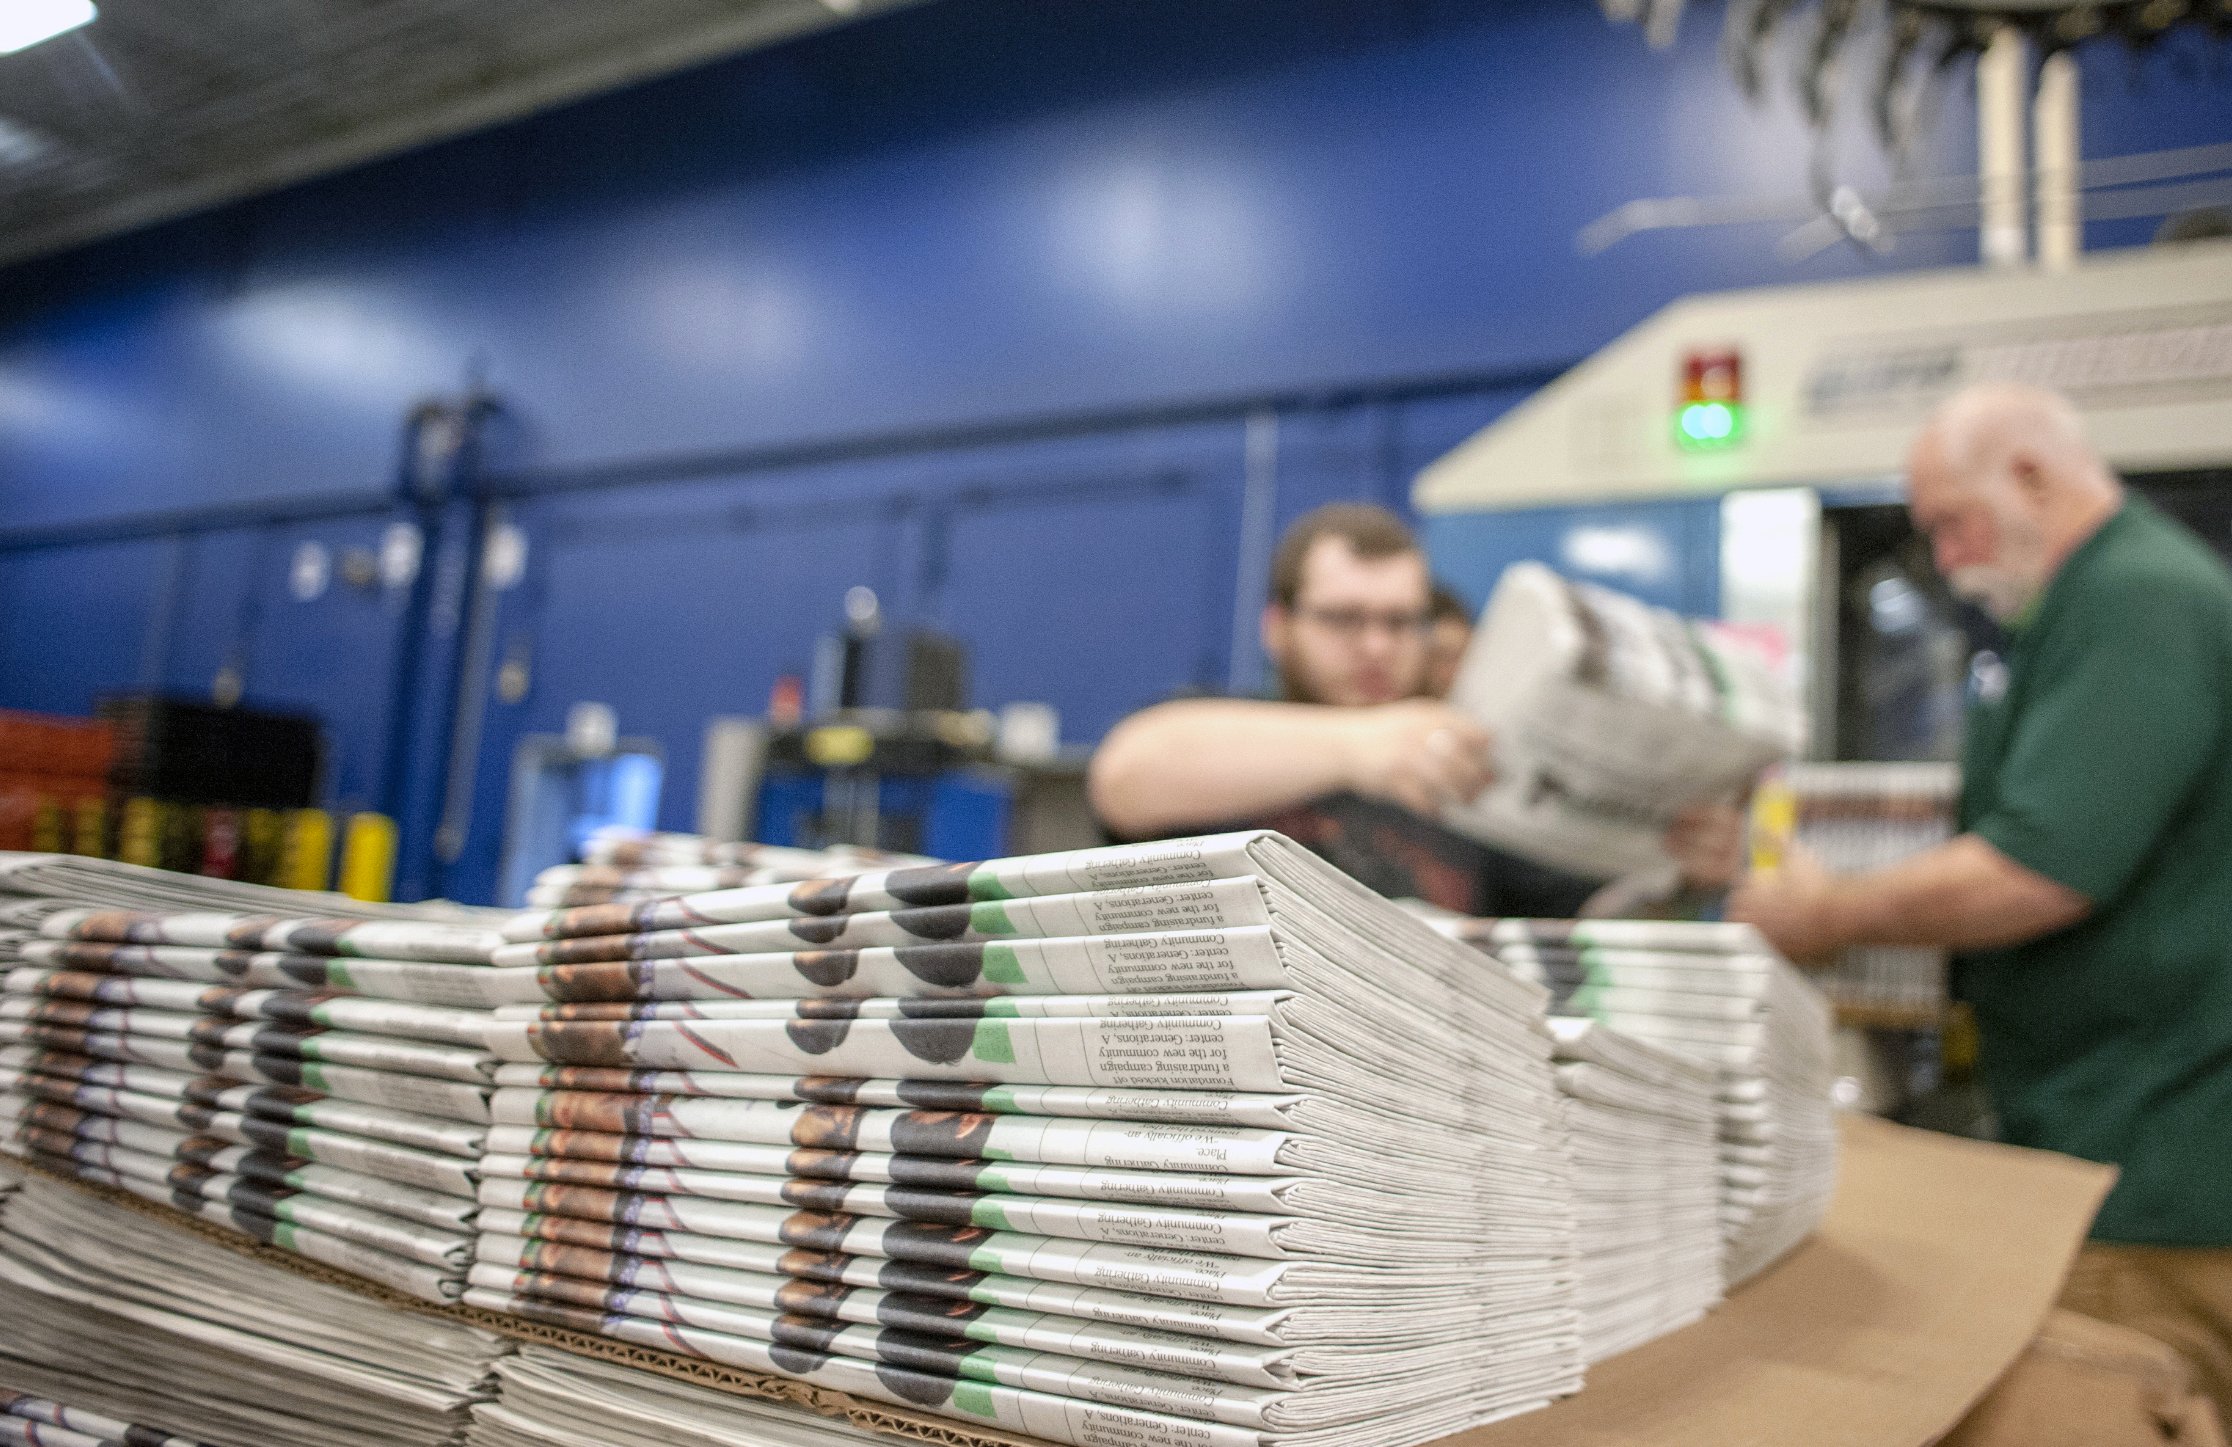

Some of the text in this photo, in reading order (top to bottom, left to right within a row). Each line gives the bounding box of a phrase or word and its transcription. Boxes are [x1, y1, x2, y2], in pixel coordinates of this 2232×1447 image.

[1094, 891, 1214, 911] center: Generations, A
[1182, 905, 1200, 914] the
[1202, 903, 1220, 913] for
[1095, 909, 1154, 922] community
[1098, 914, 1224, 932] a fundraising campaign
[1104, 934, 1225, 950] Community Gathering
[1108, 946, 1229, 963] center: Generations, A
[1107, 964, 1167, 974] community
[1196, 962, 1214, 971] the
[1217, 959, 1234, 970] for
[1111, 976, 1164, 986] campaign
[1167, 972, 1230, 982] fundraising
[1100, 1019, 1222, 1031] Community Gathering
[1102, 1034, 1224, 1045] center: Generations, A
[1099, 1047, 1227, 1060] for the new community
[1100, 1060, 1230, 1074] a fundraising campaign
[1113, 1076, 1235, 1086] Foundation kicked off
[1105, 1095, 1229, 1111] Community Gathering
[1123, 1130, 1142, 1139] an-
[1144, 1130, 1193, 1143] officially
[1100, 1180, 1225, 1198] Community Gathering
[1098, 1213, 1222, 1234] Community Gathering
[1143, 1253, 1194, 1266] officially
[1094, 1267, 1220, 1291] Community Gathering
[1093, 1307, 1219, 1333] Community Gathering
[1090, 1342, 1216, 1369] Community Gathering
[1084, 1409, 1094, 1420] A
[1096, 1411, 1168, 1434] Generations,
[1081, 1420, 1145, 1440] community
[1170, 1424, 1211, 1440] center:
[1148, 1434, 1172, 1446] new
